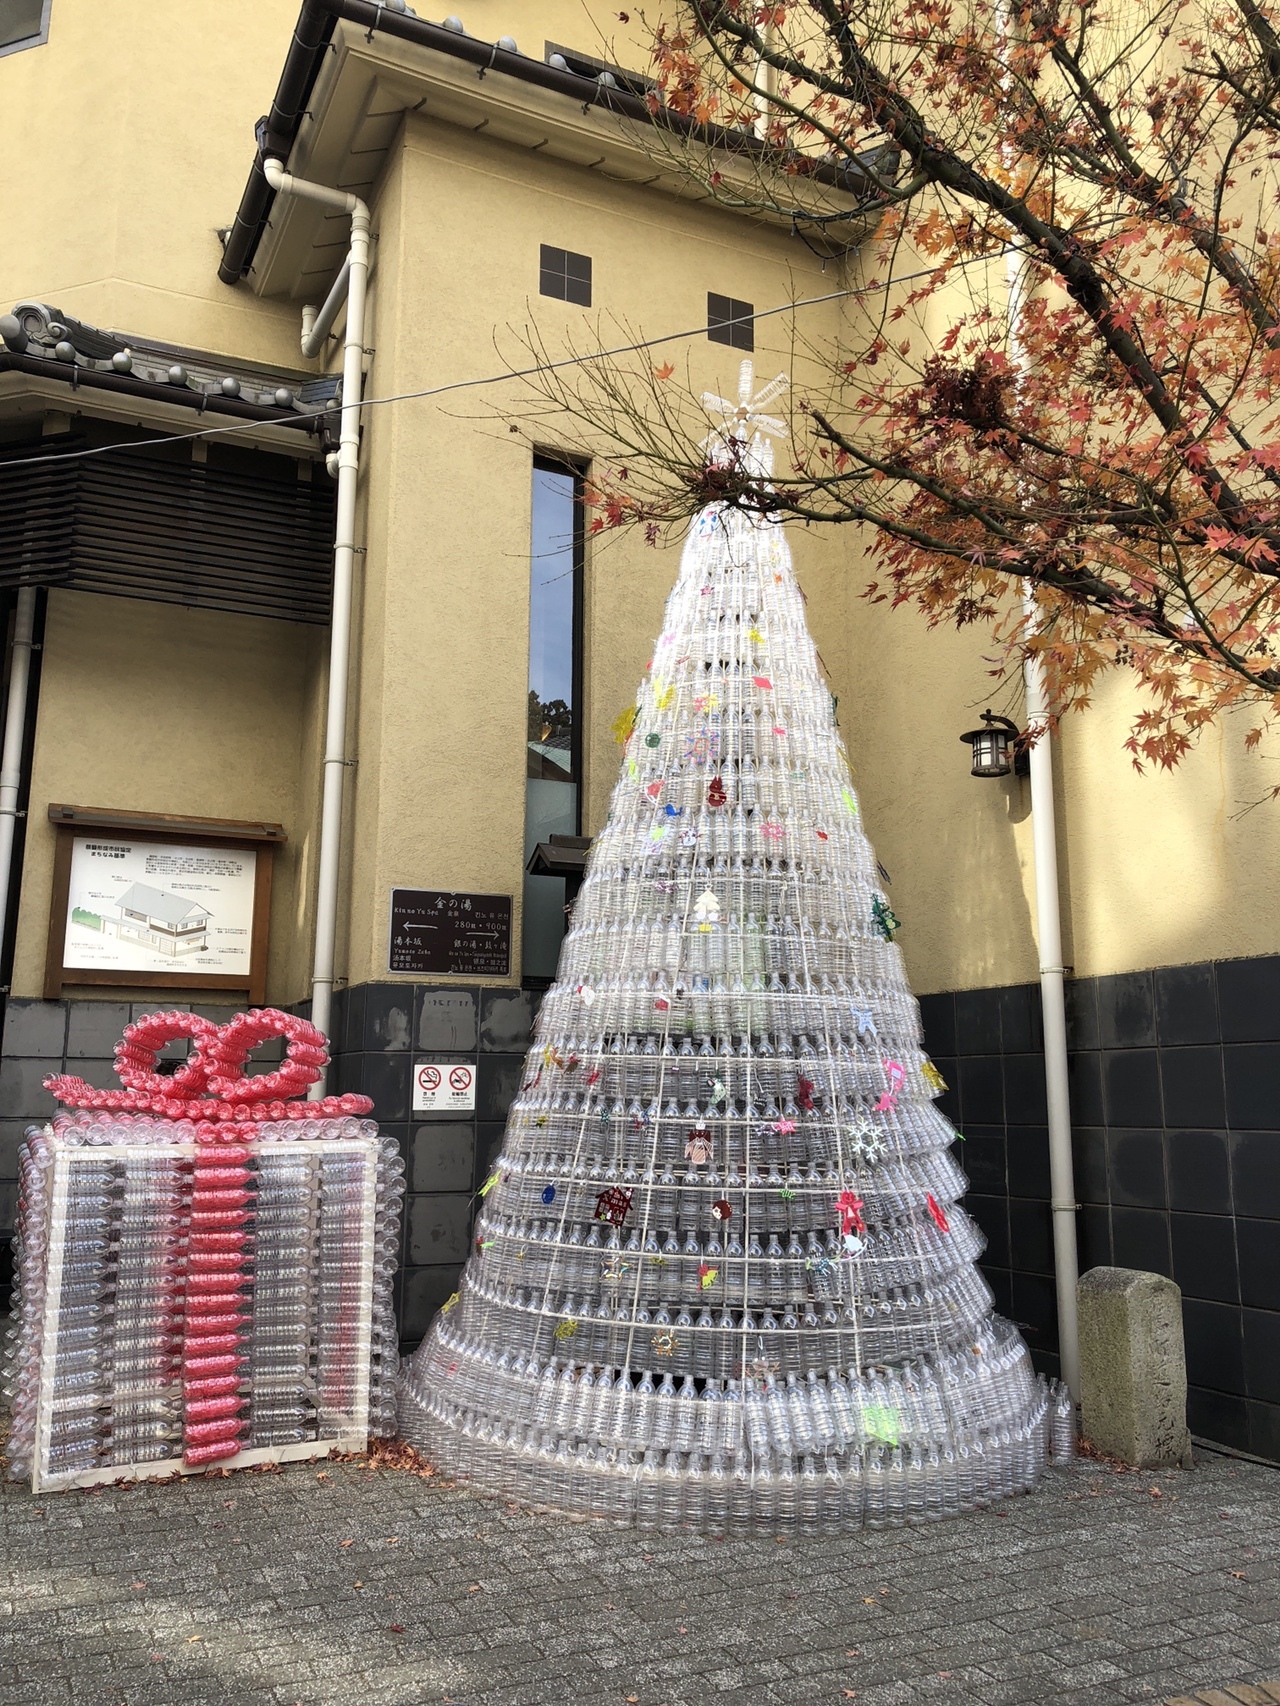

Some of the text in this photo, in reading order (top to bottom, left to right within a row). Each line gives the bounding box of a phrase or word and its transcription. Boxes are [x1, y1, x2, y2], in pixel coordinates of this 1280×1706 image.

[434, 896, 472, 912] 金の湯
[394, 936, 422, 946] 湯本坂
